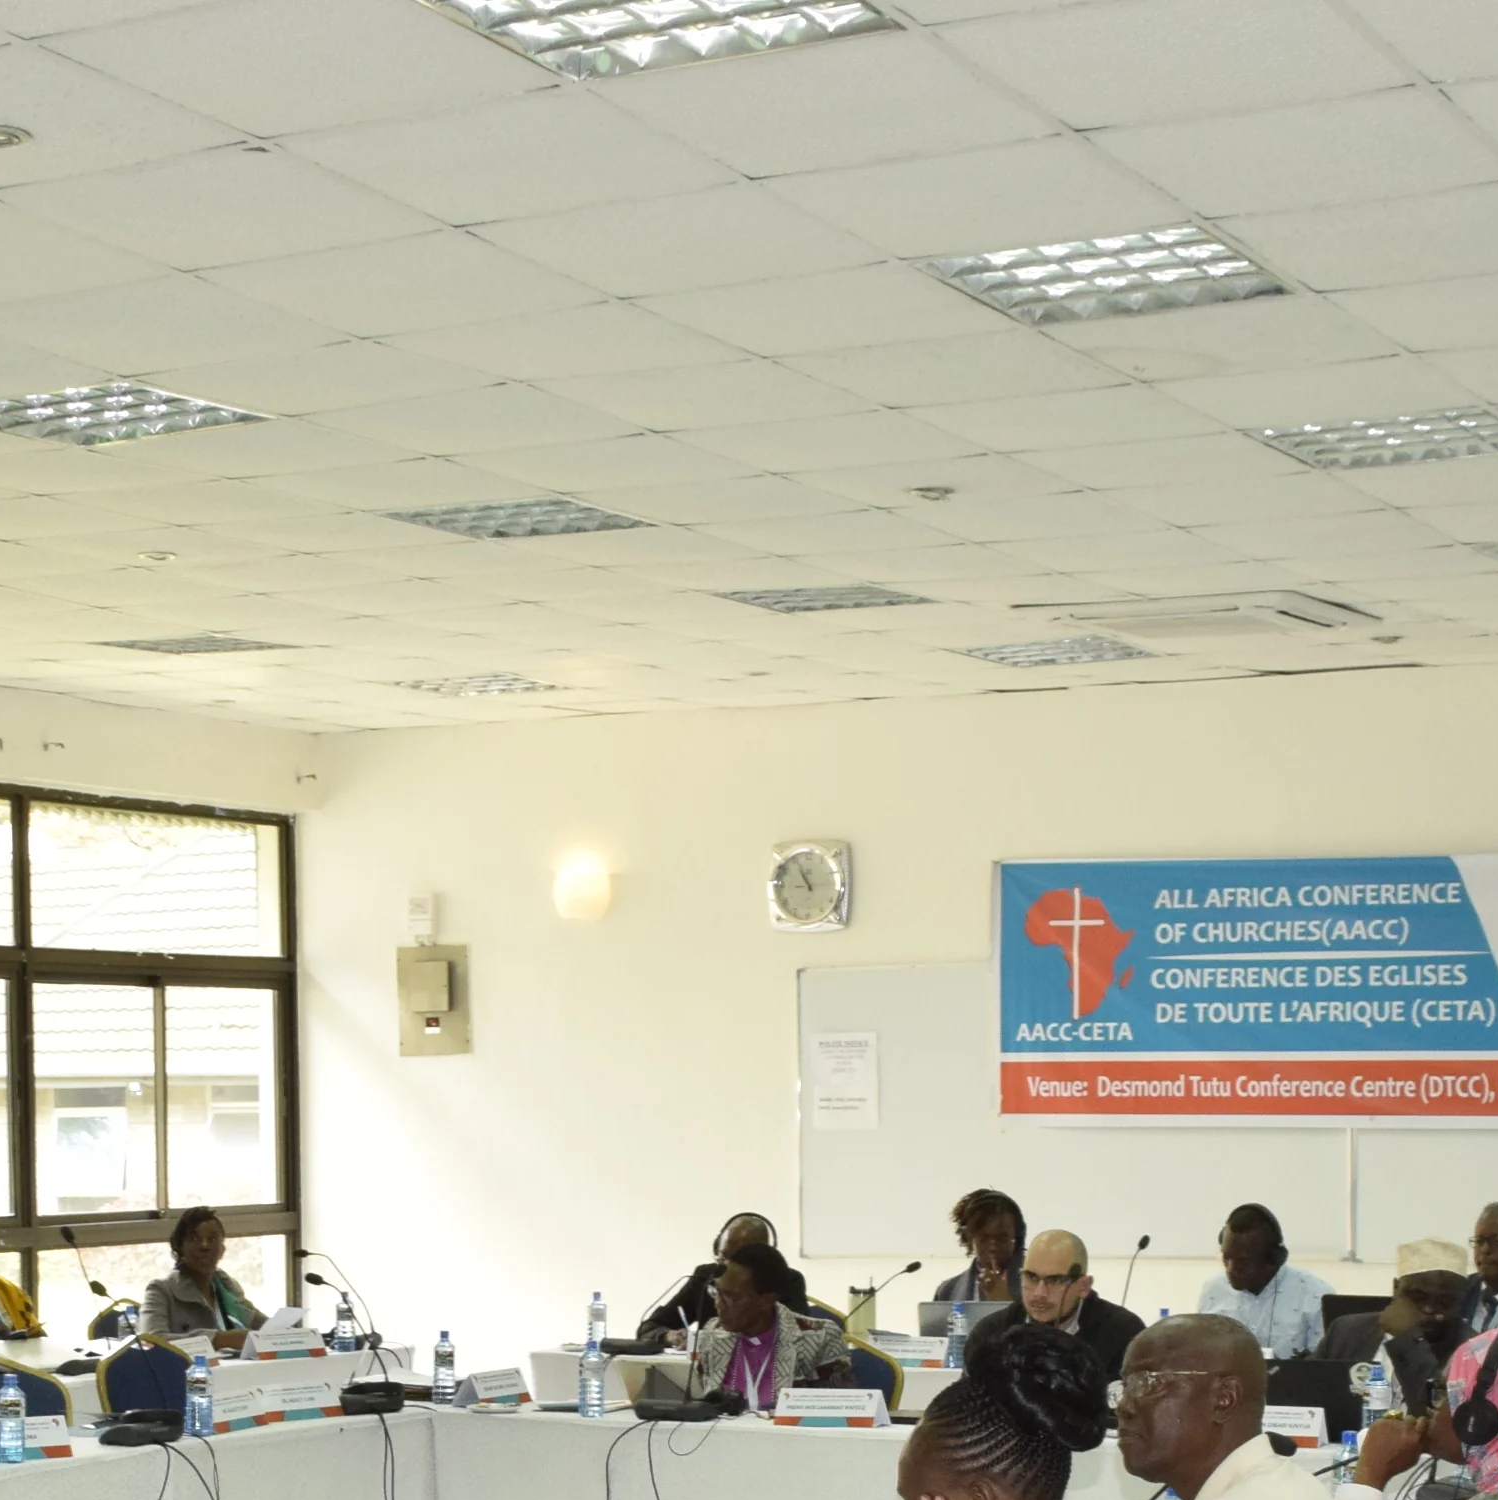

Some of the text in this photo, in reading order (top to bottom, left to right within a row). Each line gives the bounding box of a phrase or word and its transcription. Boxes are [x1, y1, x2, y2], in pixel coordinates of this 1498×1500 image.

[1154, 882, 1462, 909] ALL AFRICA CONFERENCE
[1155, 917, 1410, 947] OF CHURCHES(AACC)
[1151, 963, 1468, 989] CONFERENCE DES EGLISES
[1156, 1002, 1187, 1023] DE
[1194, 1000, 1275, 1023] TOUTE
[1411, 998, 1497, 1028] (CETA)
[1016, 1021, 1134, 1042] AACC-CETA
[1027, 1075, 1089, 1098] Venue:
[1097, 1074, 1186, 1098] Desmond
[1189, 1075, 1232, 1098] Tutu
[1235, 1073, 1347, 1098] Conference
[1350, 1075, 1417, 1098] Centre
[1421, 1074, 1496, 1104] (DTCC),
